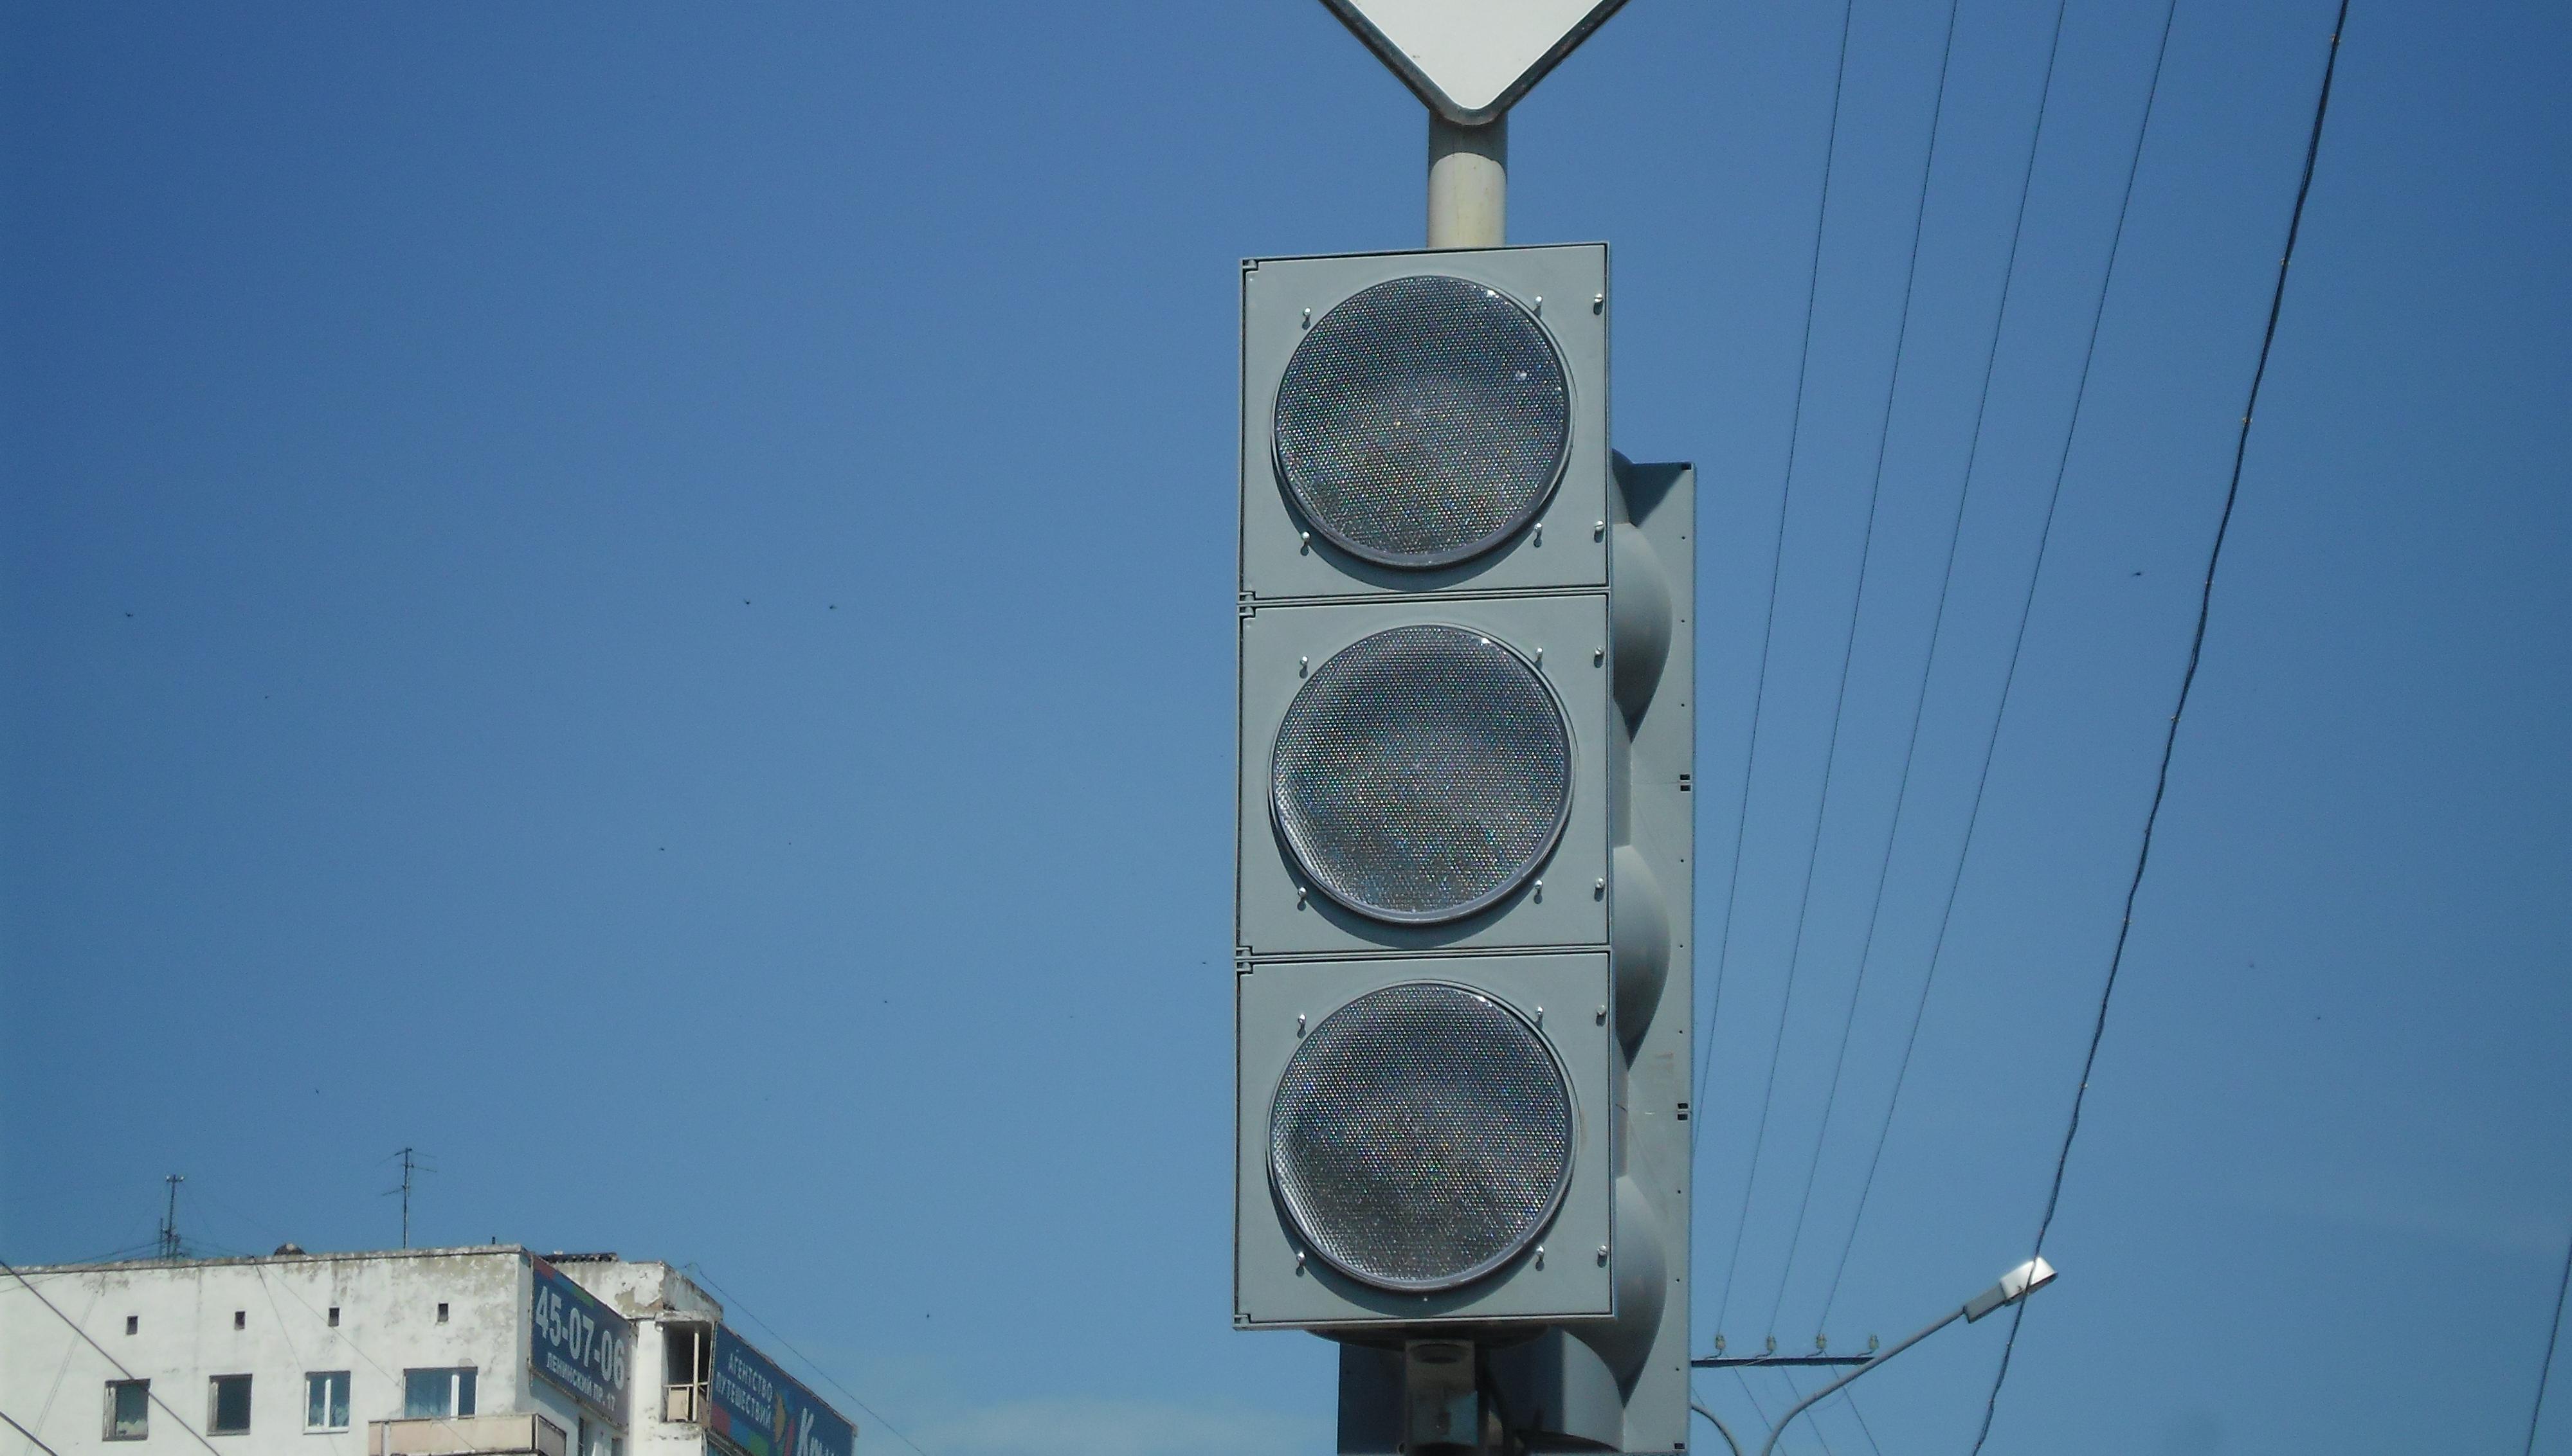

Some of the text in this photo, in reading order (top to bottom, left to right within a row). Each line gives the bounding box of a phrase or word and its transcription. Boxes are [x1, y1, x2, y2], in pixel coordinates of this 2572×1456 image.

[536, 1286, 625, 1390] 45-07-06
[547, 1352, 592, 1397] ЛЕНИНСКИЙ
[728, 1353, 772, 1403] АГЕНТСТВО
